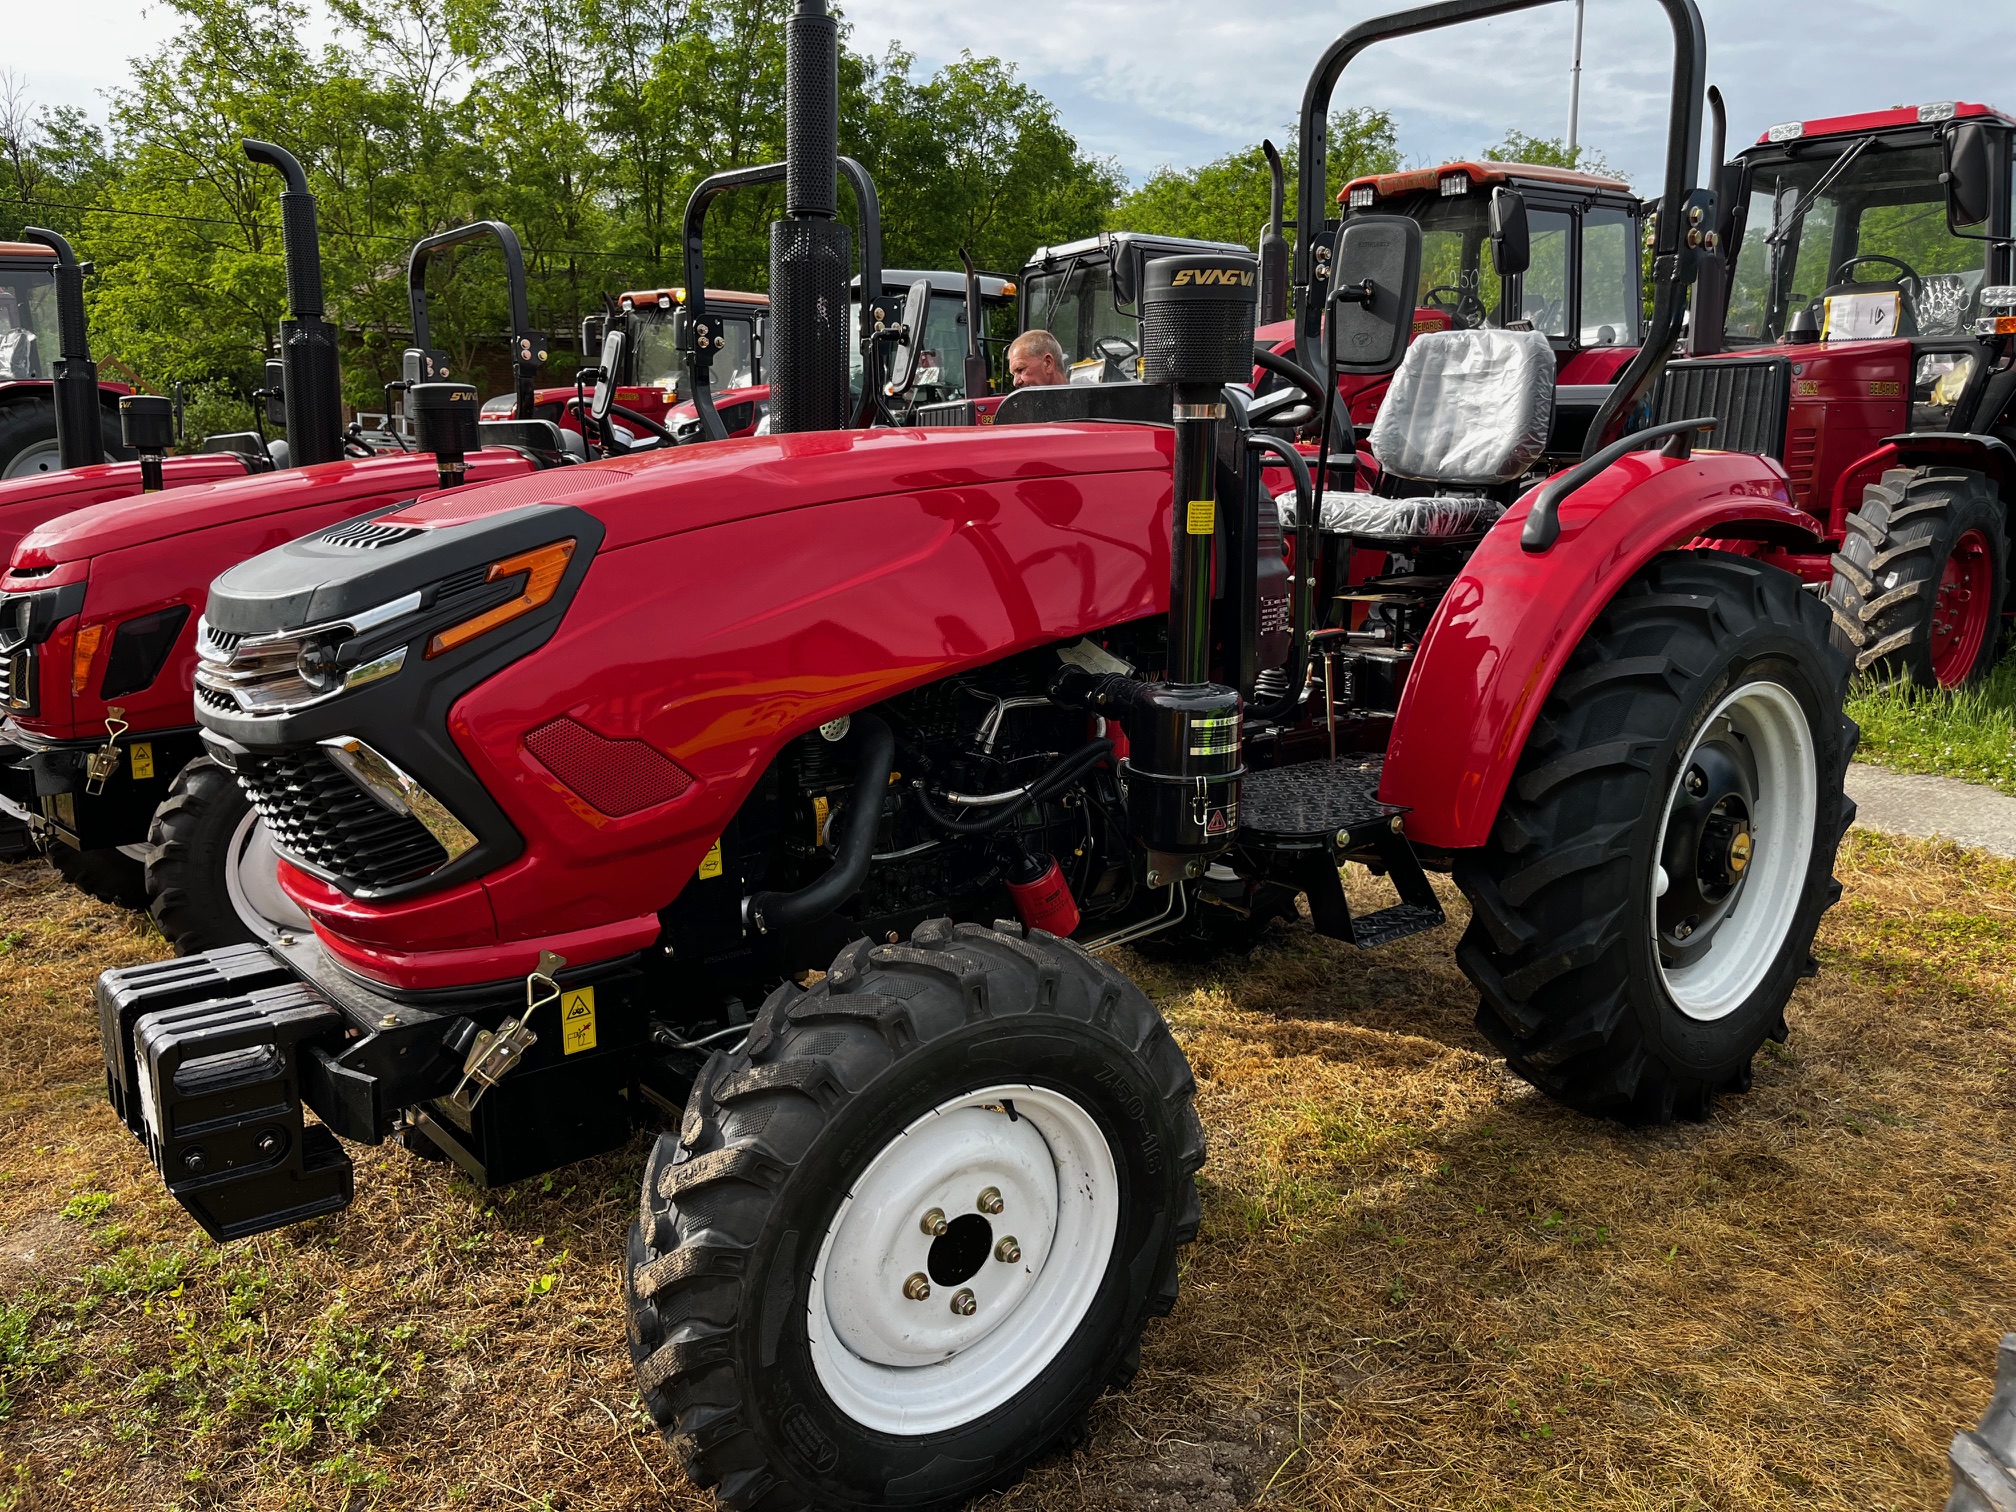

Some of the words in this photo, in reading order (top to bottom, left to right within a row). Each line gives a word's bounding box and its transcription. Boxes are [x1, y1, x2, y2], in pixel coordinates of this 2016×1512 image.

[1412, 319, 1443, 333] BELARUS
[1869, 381, 1900, 396] BELARUS
[1094, 1062, 1163, 1175] 7.50-16
